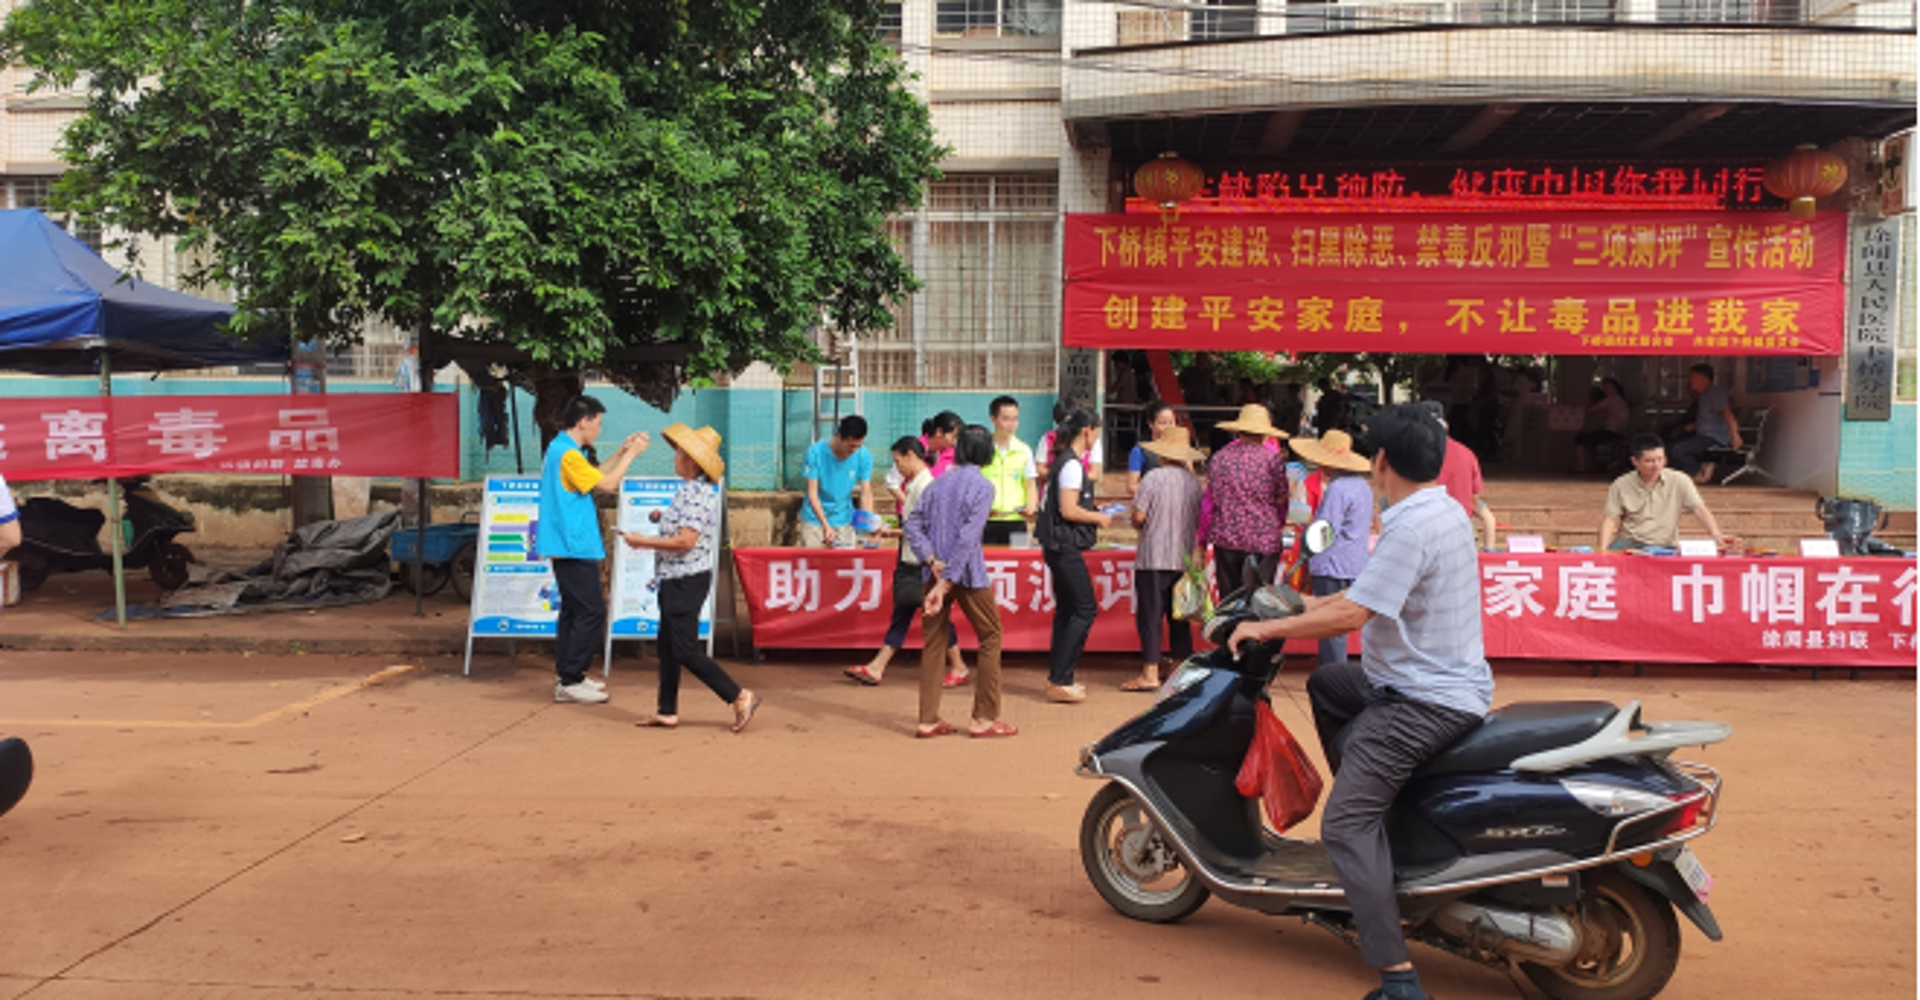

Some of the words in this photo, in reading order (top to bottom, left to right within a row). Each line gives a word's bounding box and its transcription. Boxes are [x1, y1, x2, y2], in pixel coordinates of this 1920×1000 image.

[1103, 294, 1801, 336] 创建平安家庭，不让毒品进我家
[0, 408, 340, 461] 离毒品
[1482, 561, 1620, 621] 家庭
[1762, 628, 1869, 649] 徐闻县妇联
